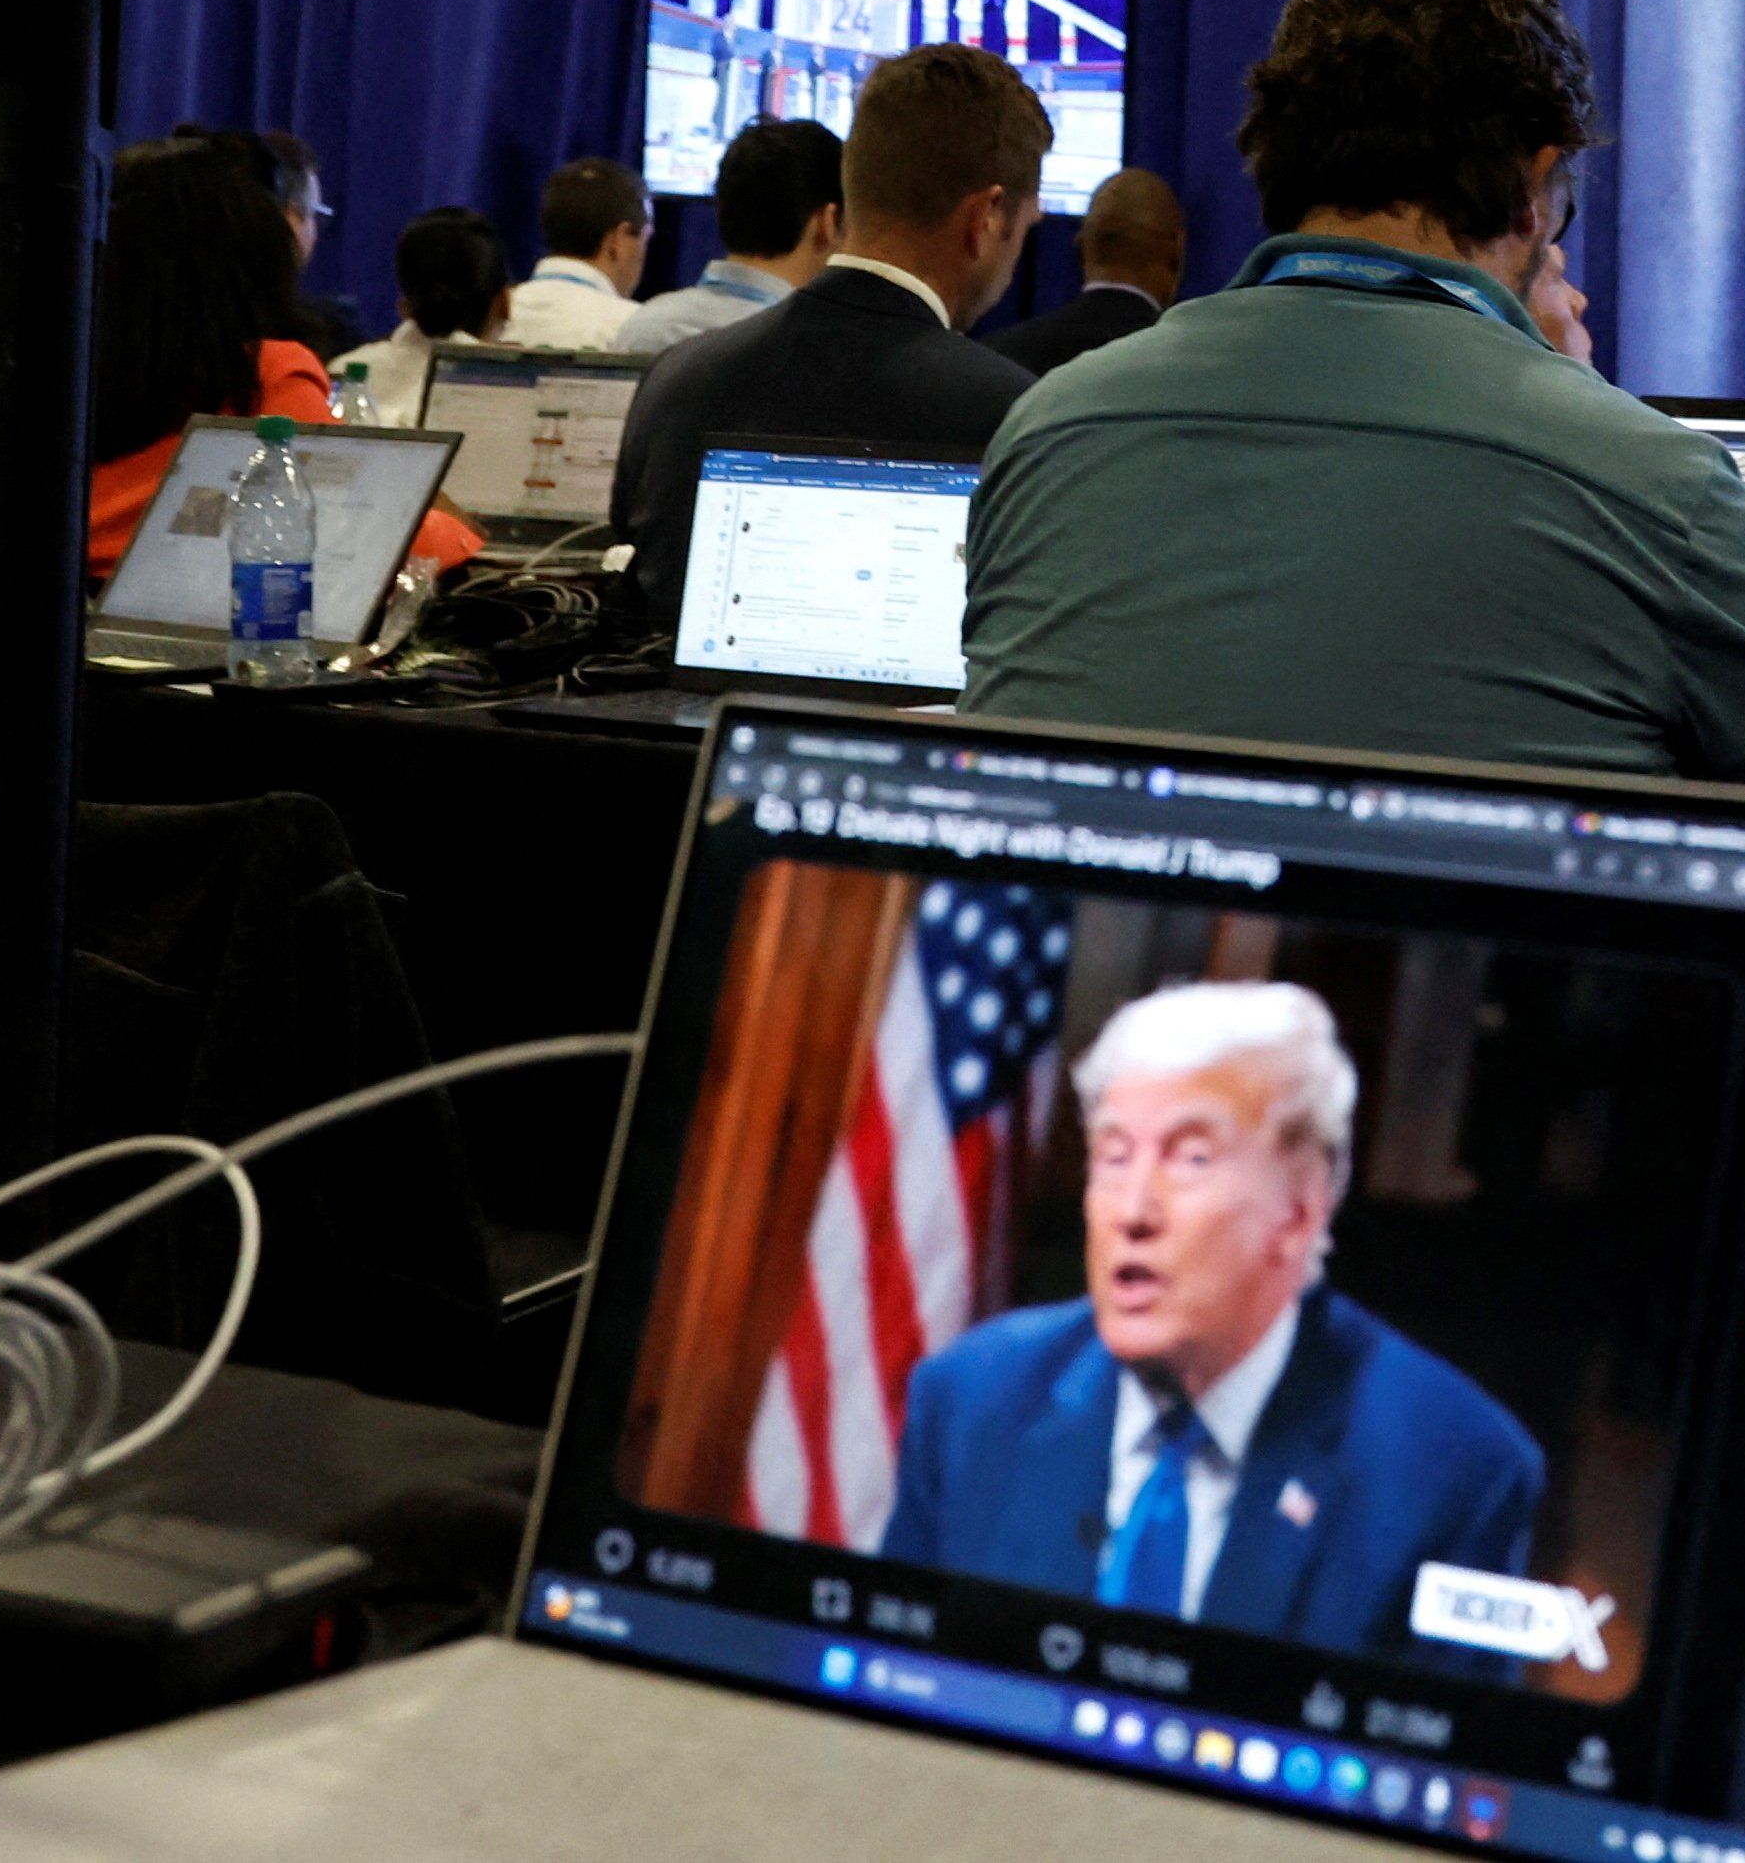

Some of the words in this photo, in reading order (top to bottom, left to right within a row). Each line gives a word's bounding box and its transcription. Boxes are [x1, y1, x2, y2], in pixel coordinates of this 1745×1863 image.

[836, 801, 932, 846] Debate
[935, 813, 1008, 858] Night
[1006, 823, 1066, 859] with
[1066, 826, 1169, 874] Donald
[1188, 837, 1281, 890] Trump
